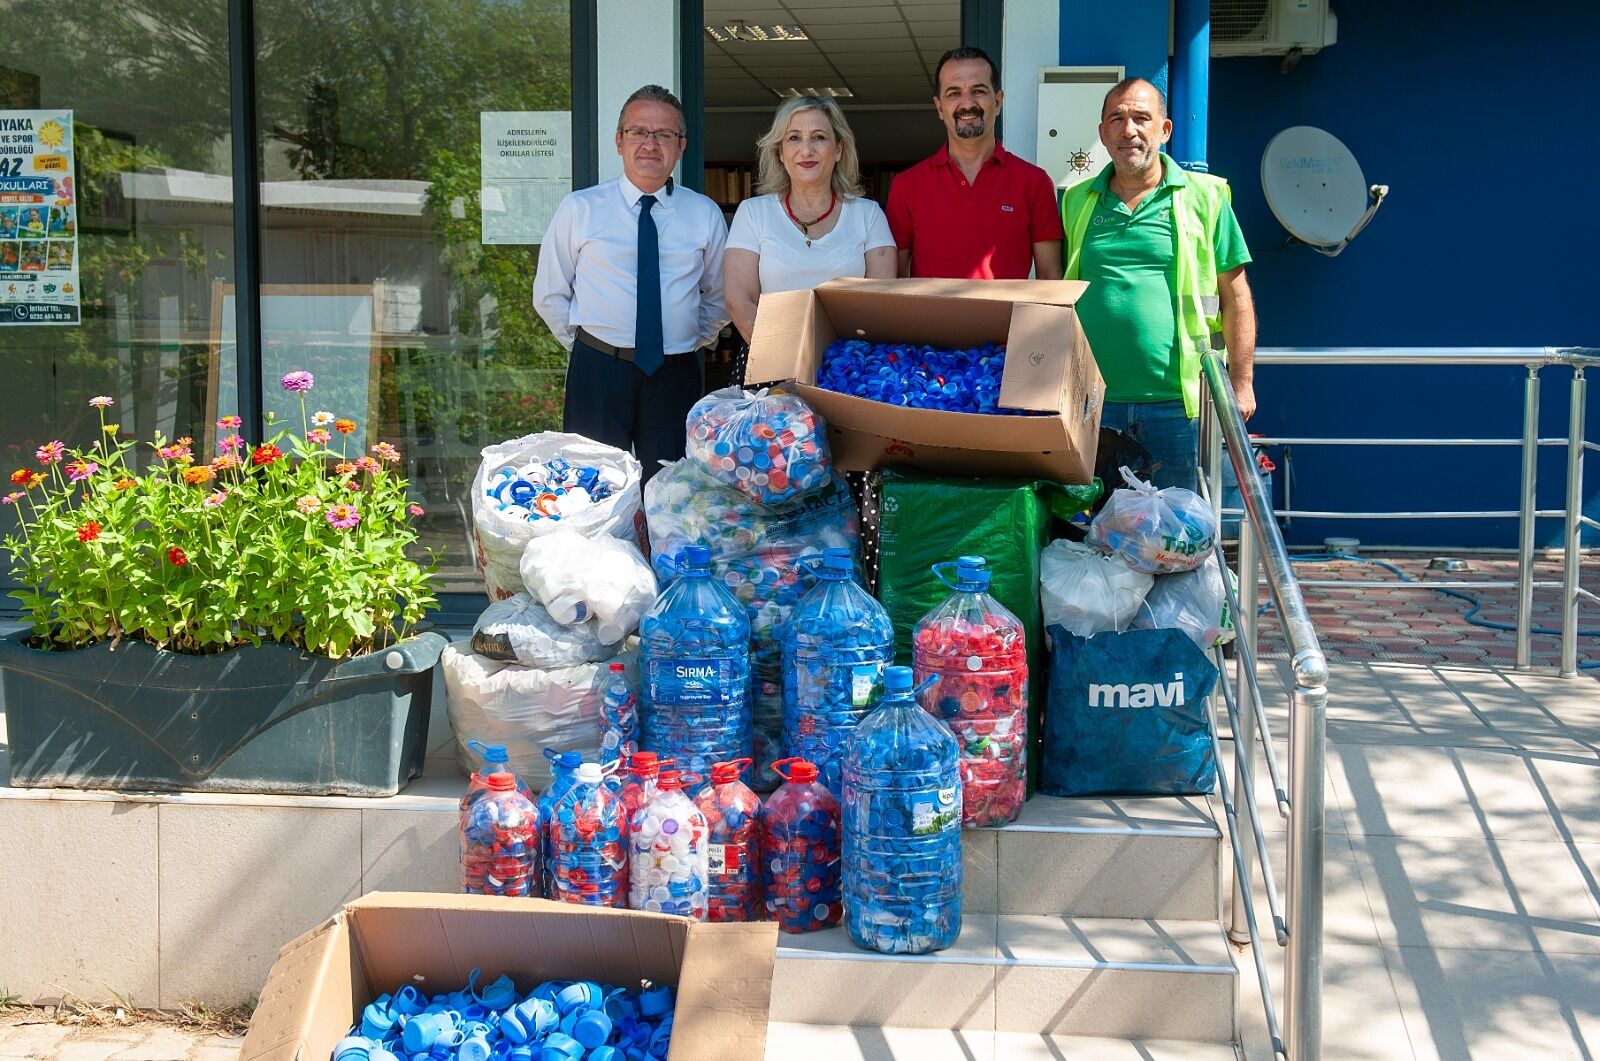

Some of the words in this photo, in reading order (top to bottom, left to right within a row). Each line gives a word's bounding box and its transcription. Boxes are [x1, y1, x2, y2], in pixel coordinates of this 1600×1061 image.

[1, 135, 10, 143] VE
[12, 135, 33, 143] SPOR
[506, 128, 547, 136] ADRESLERİN
[0, 157, 24, 177] AZ
[1088, 672, 1184, 708] mavi
